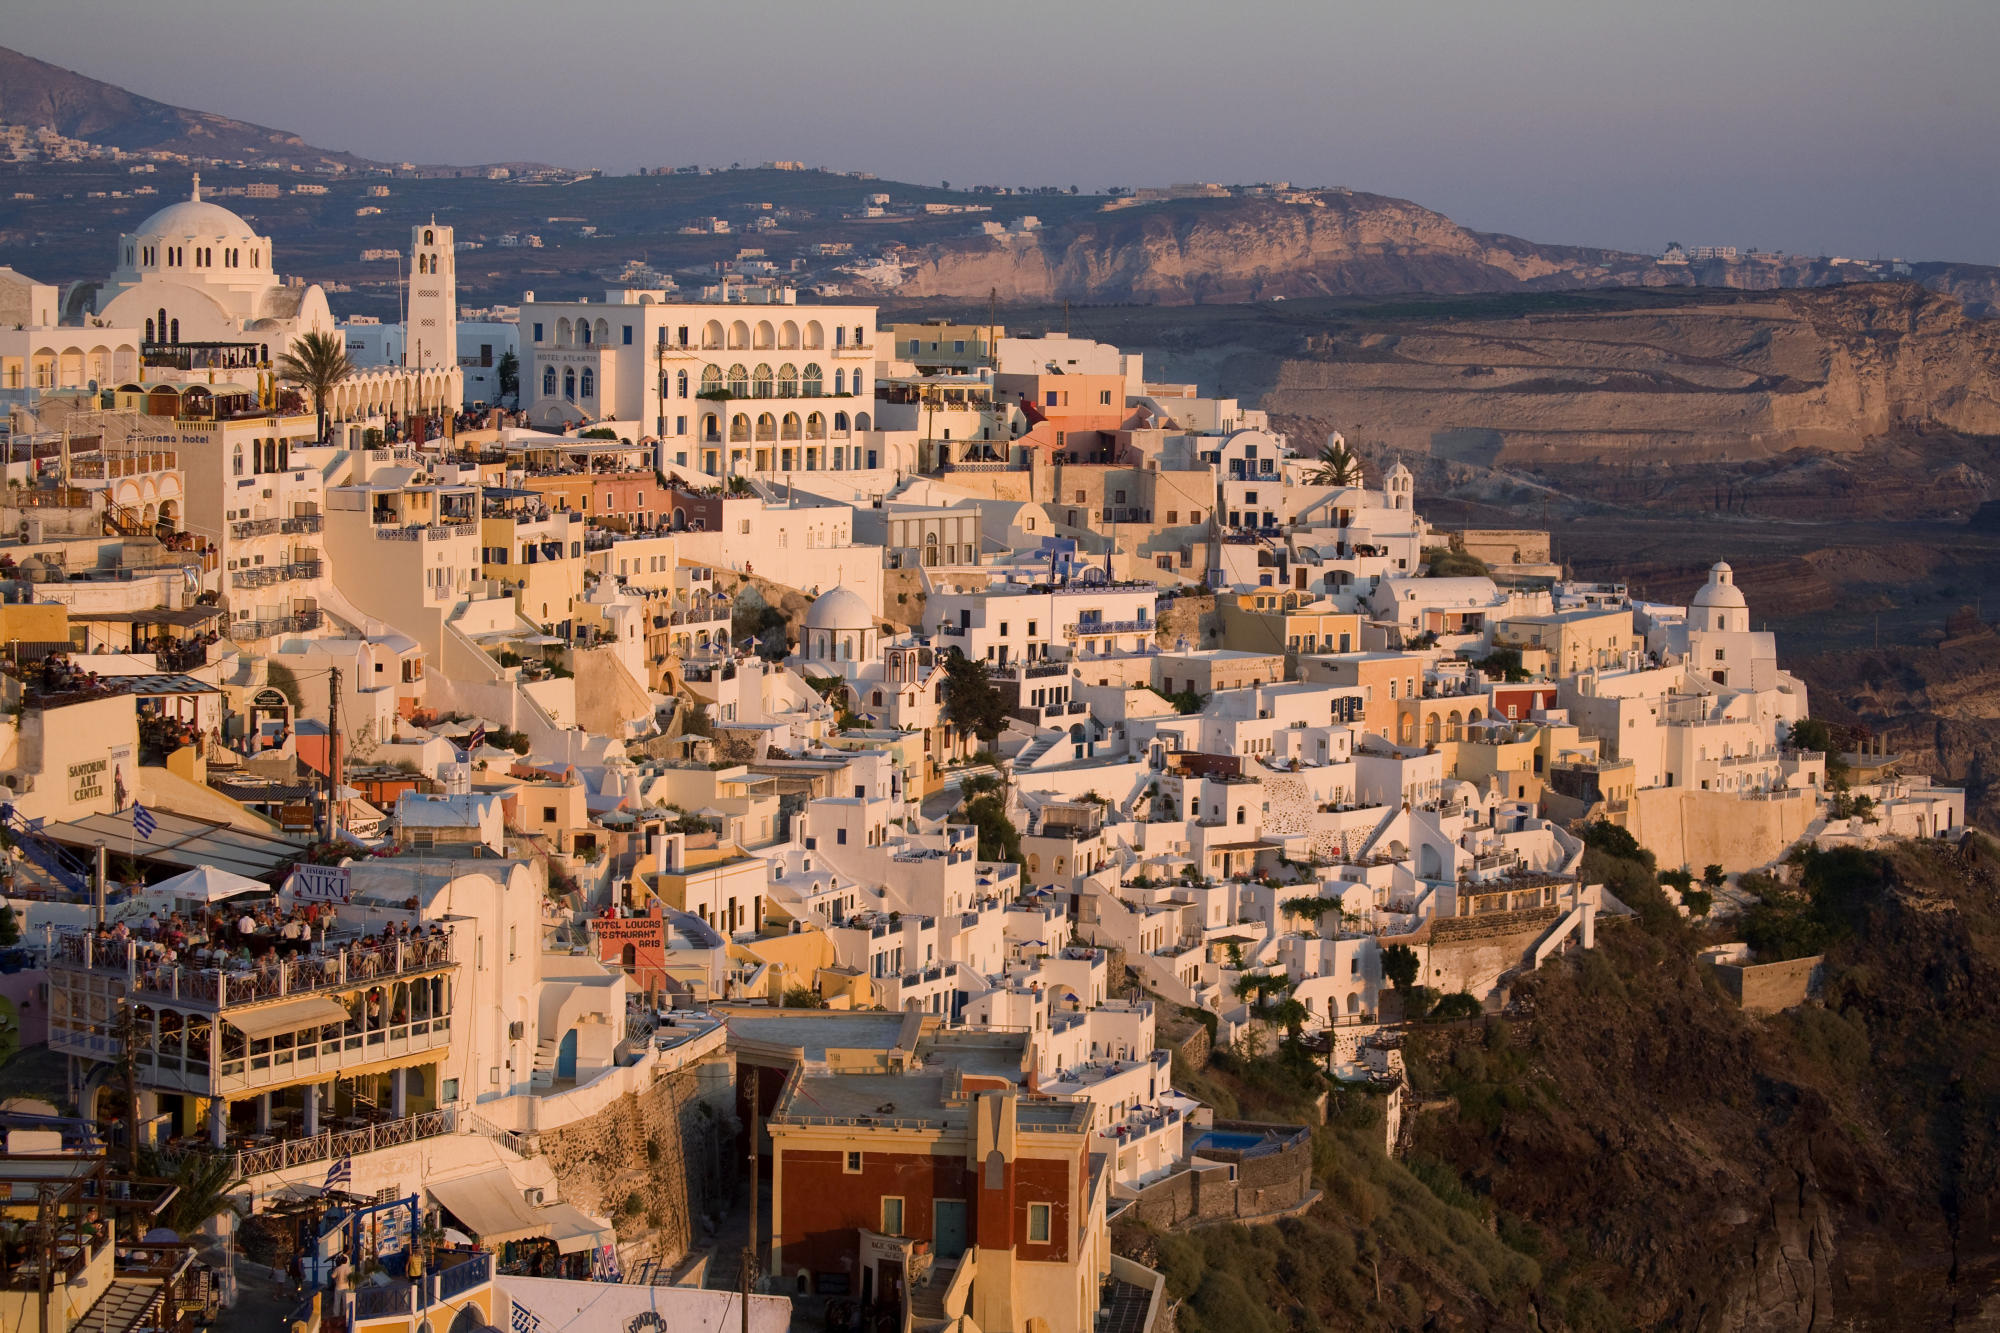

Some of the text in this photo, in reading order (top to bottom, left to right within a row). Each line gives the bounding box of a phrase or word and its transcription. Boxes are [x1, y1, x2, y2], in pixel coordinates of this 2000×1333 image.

[182, 434, 209, 444] hotel
[69, 760, 107, 778] SANTORINI
[80, 774, 97, 788] ART
[74, 785, 103, 801] CENTER
[300, 873, 345, 898] NIKI
[592, 920, 661, 929] HOTEL LOUCAS
[639, 940, 661, 948] ARIS
